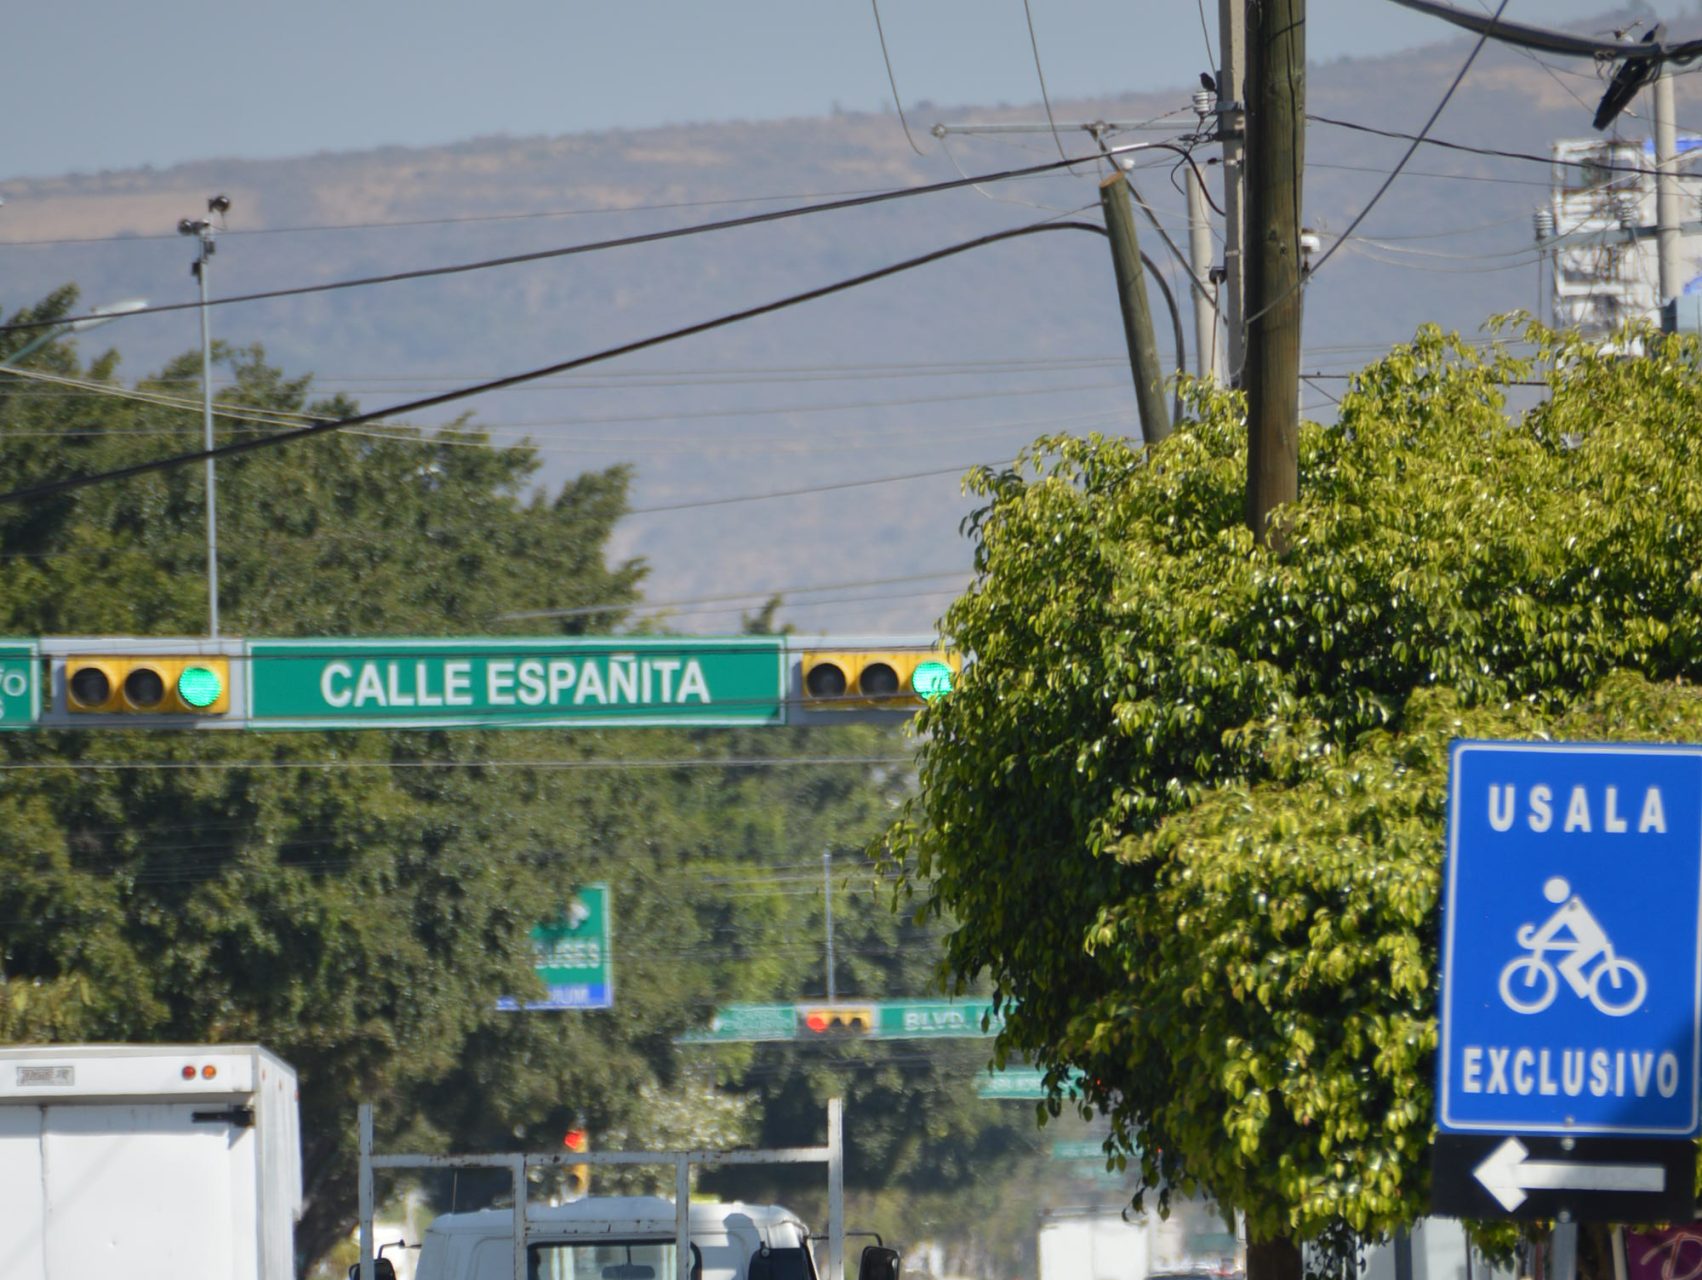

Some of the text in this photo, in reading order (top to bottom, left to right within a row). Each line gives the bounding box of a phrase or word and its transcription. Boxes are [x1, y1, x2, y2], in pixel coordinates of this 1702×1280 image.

[320, 652, 711, 707] CALLE ESPAÑITA
[1488, 784, 1667, 833] USALA
[1462, 1047, 1679, 1098] EXCLUSIVO
